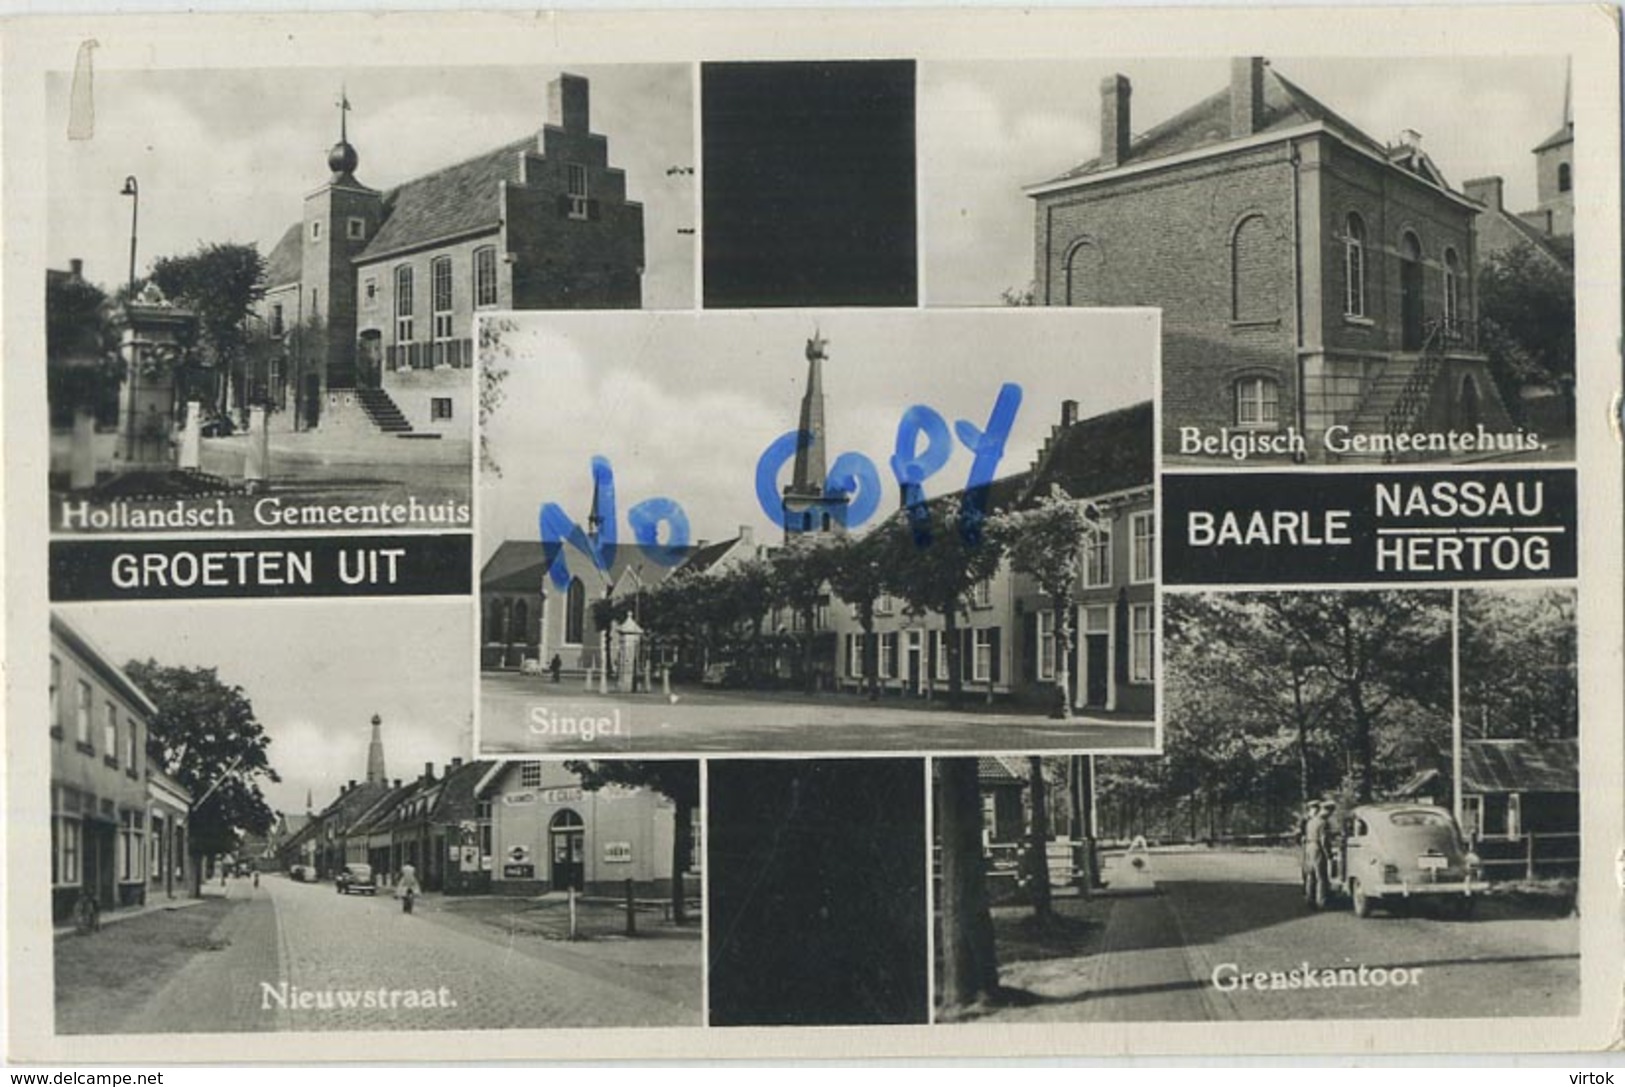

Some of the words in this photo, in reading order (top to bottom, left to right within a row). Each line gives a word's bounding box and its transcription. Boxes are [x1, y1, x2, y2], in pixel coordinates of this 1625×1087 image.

[1180, 426, 1304, 460] Belgisch
[1325, 424, 1547, 454] Gemeentehuis.
[62, 498, 234, 528] Hollandsch
[254, 496, 470, 526] Gemeentehuis
[1375, 481, 1544, 517] NASSAU
[1188, 510, 1351, 546] BAARLE
[111, 551, 313, 588] GROETEN
[338, 549, 406, 584] UIT
[1376, 535, 1551, 572] HERTOG
[529, 706, 621, 741] Singel
[1211, 961, 1423, 991] Grenskantoor
[260, 981, 457, 1009] Nieuwstraat.
